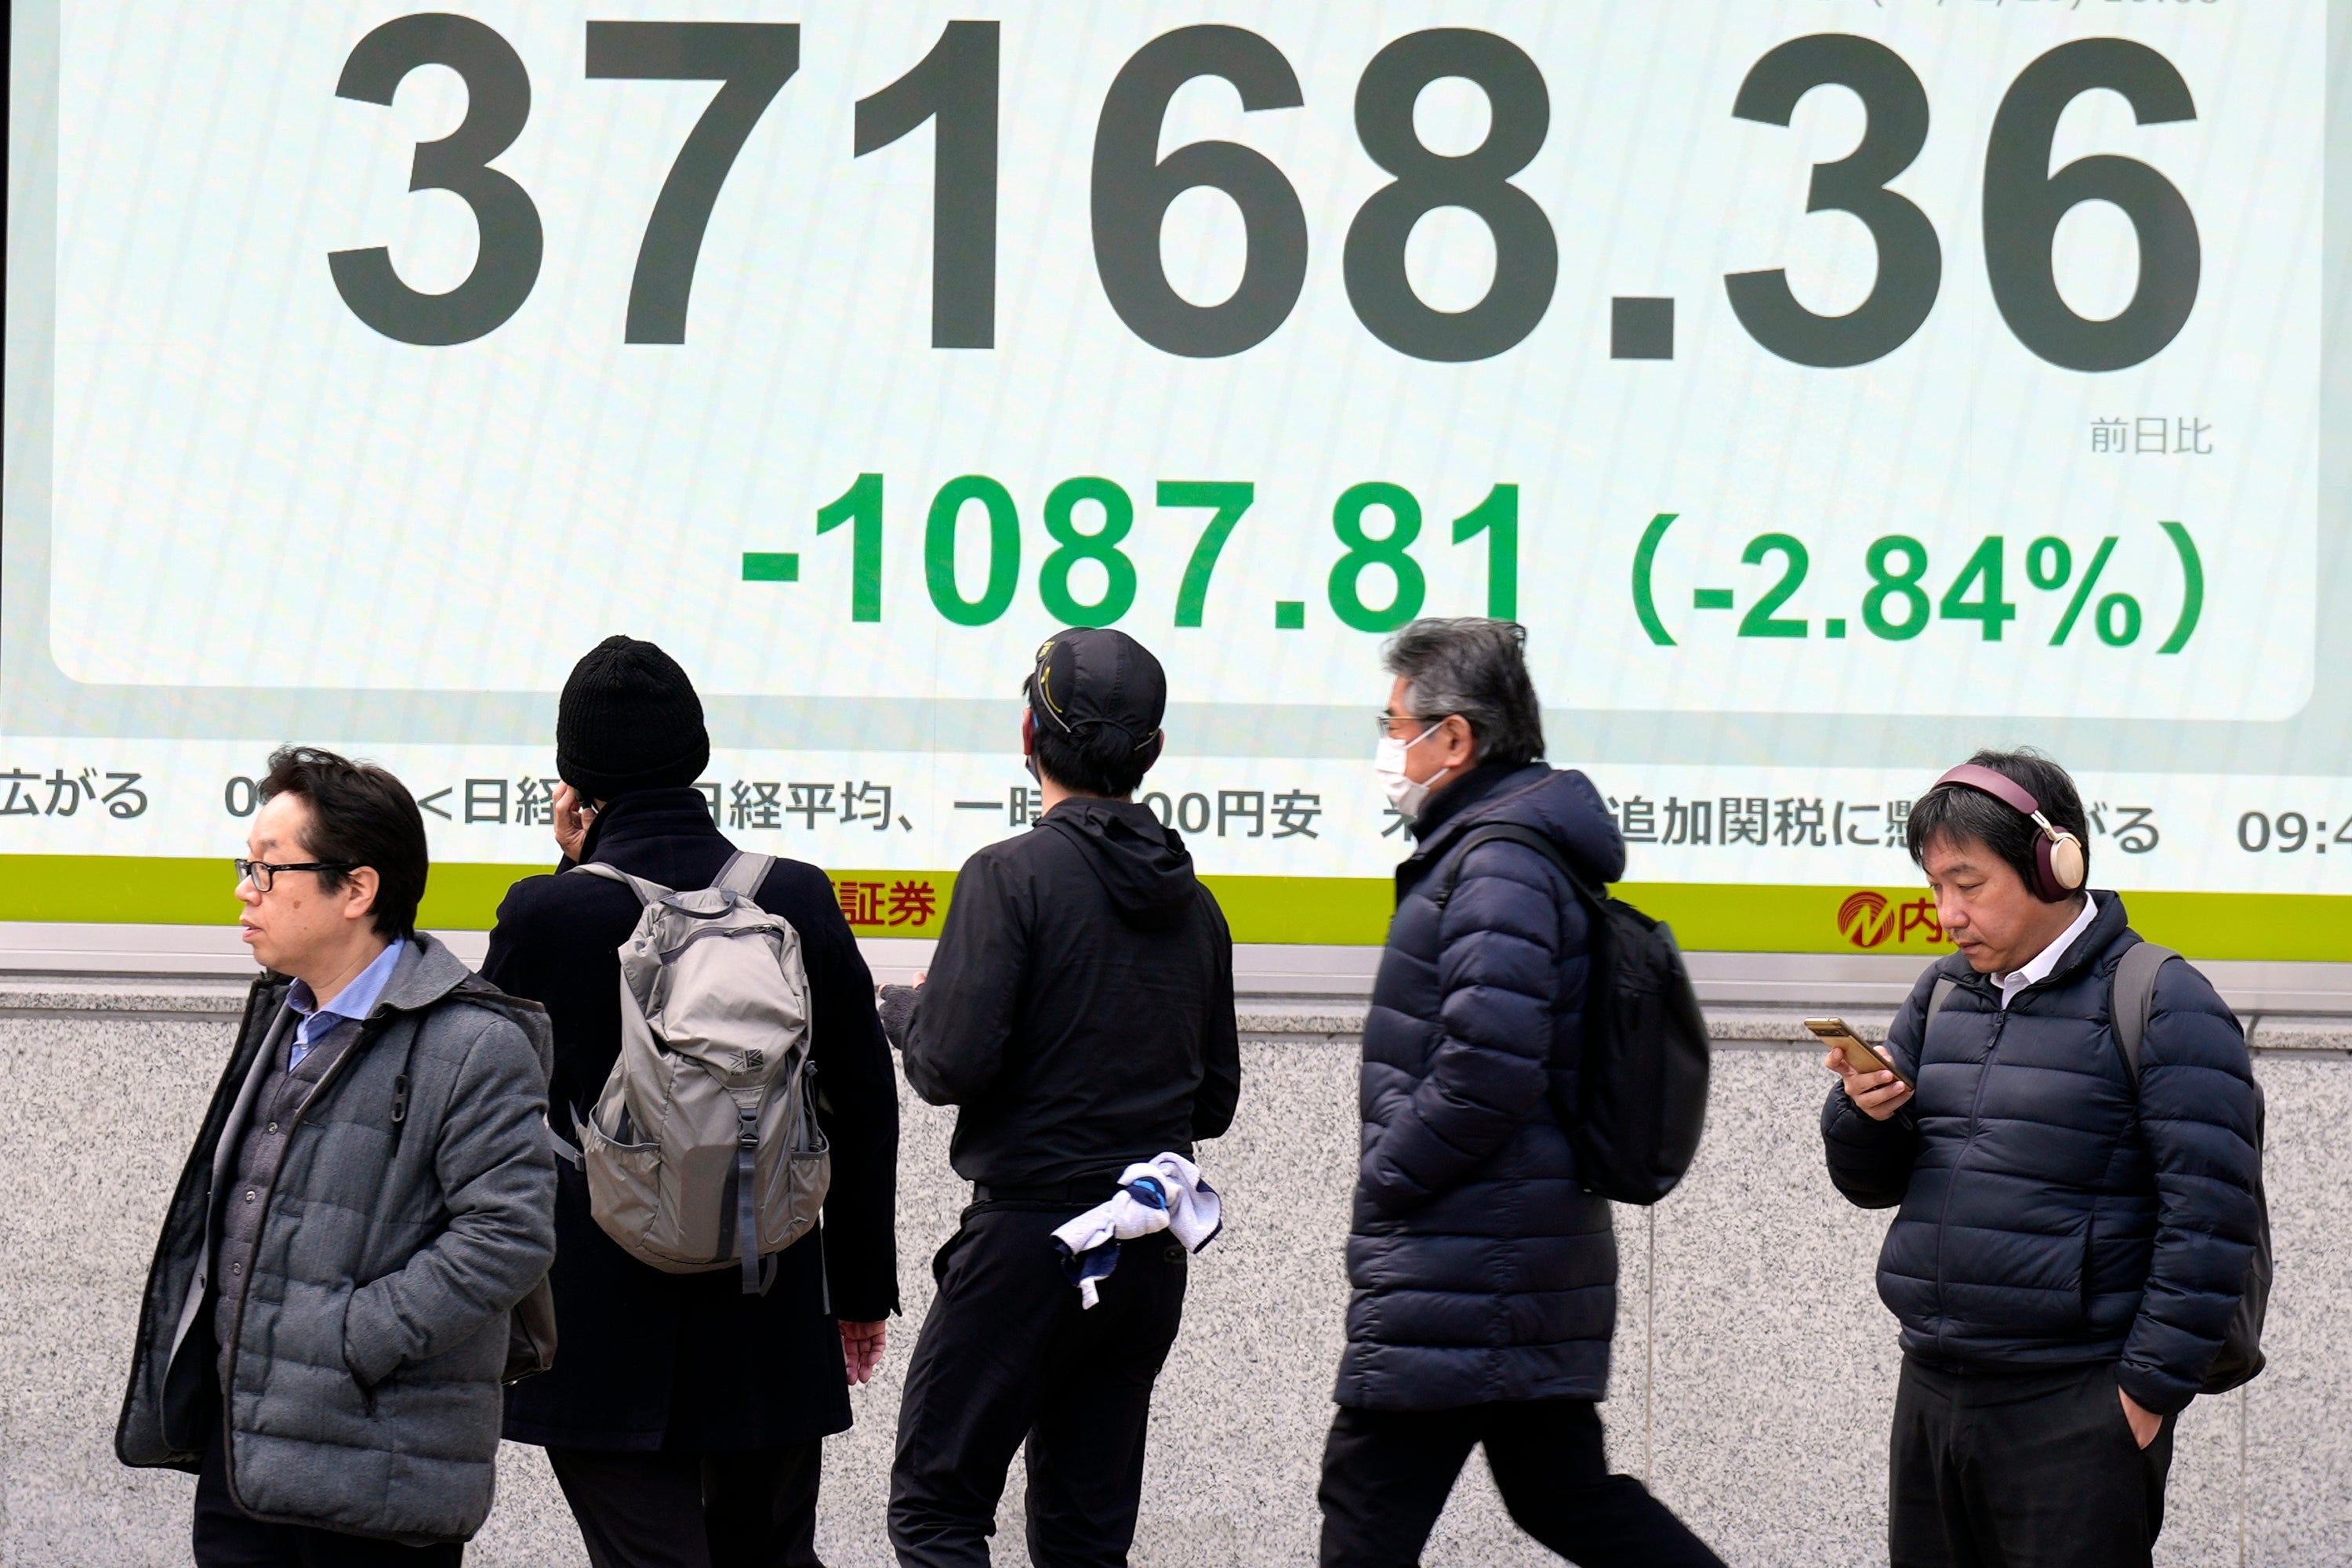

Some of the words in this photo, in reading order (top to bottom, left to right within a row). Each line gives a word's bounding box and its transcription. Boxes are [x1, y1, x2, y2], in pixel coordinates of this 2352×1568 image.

[328, 13, 2201, 372] 37168.36
[2090, 416, 2213, 455] 前日比
[742, 473, 1519, 633] -1087.81
[0, 768, 147, 819] 広がる
